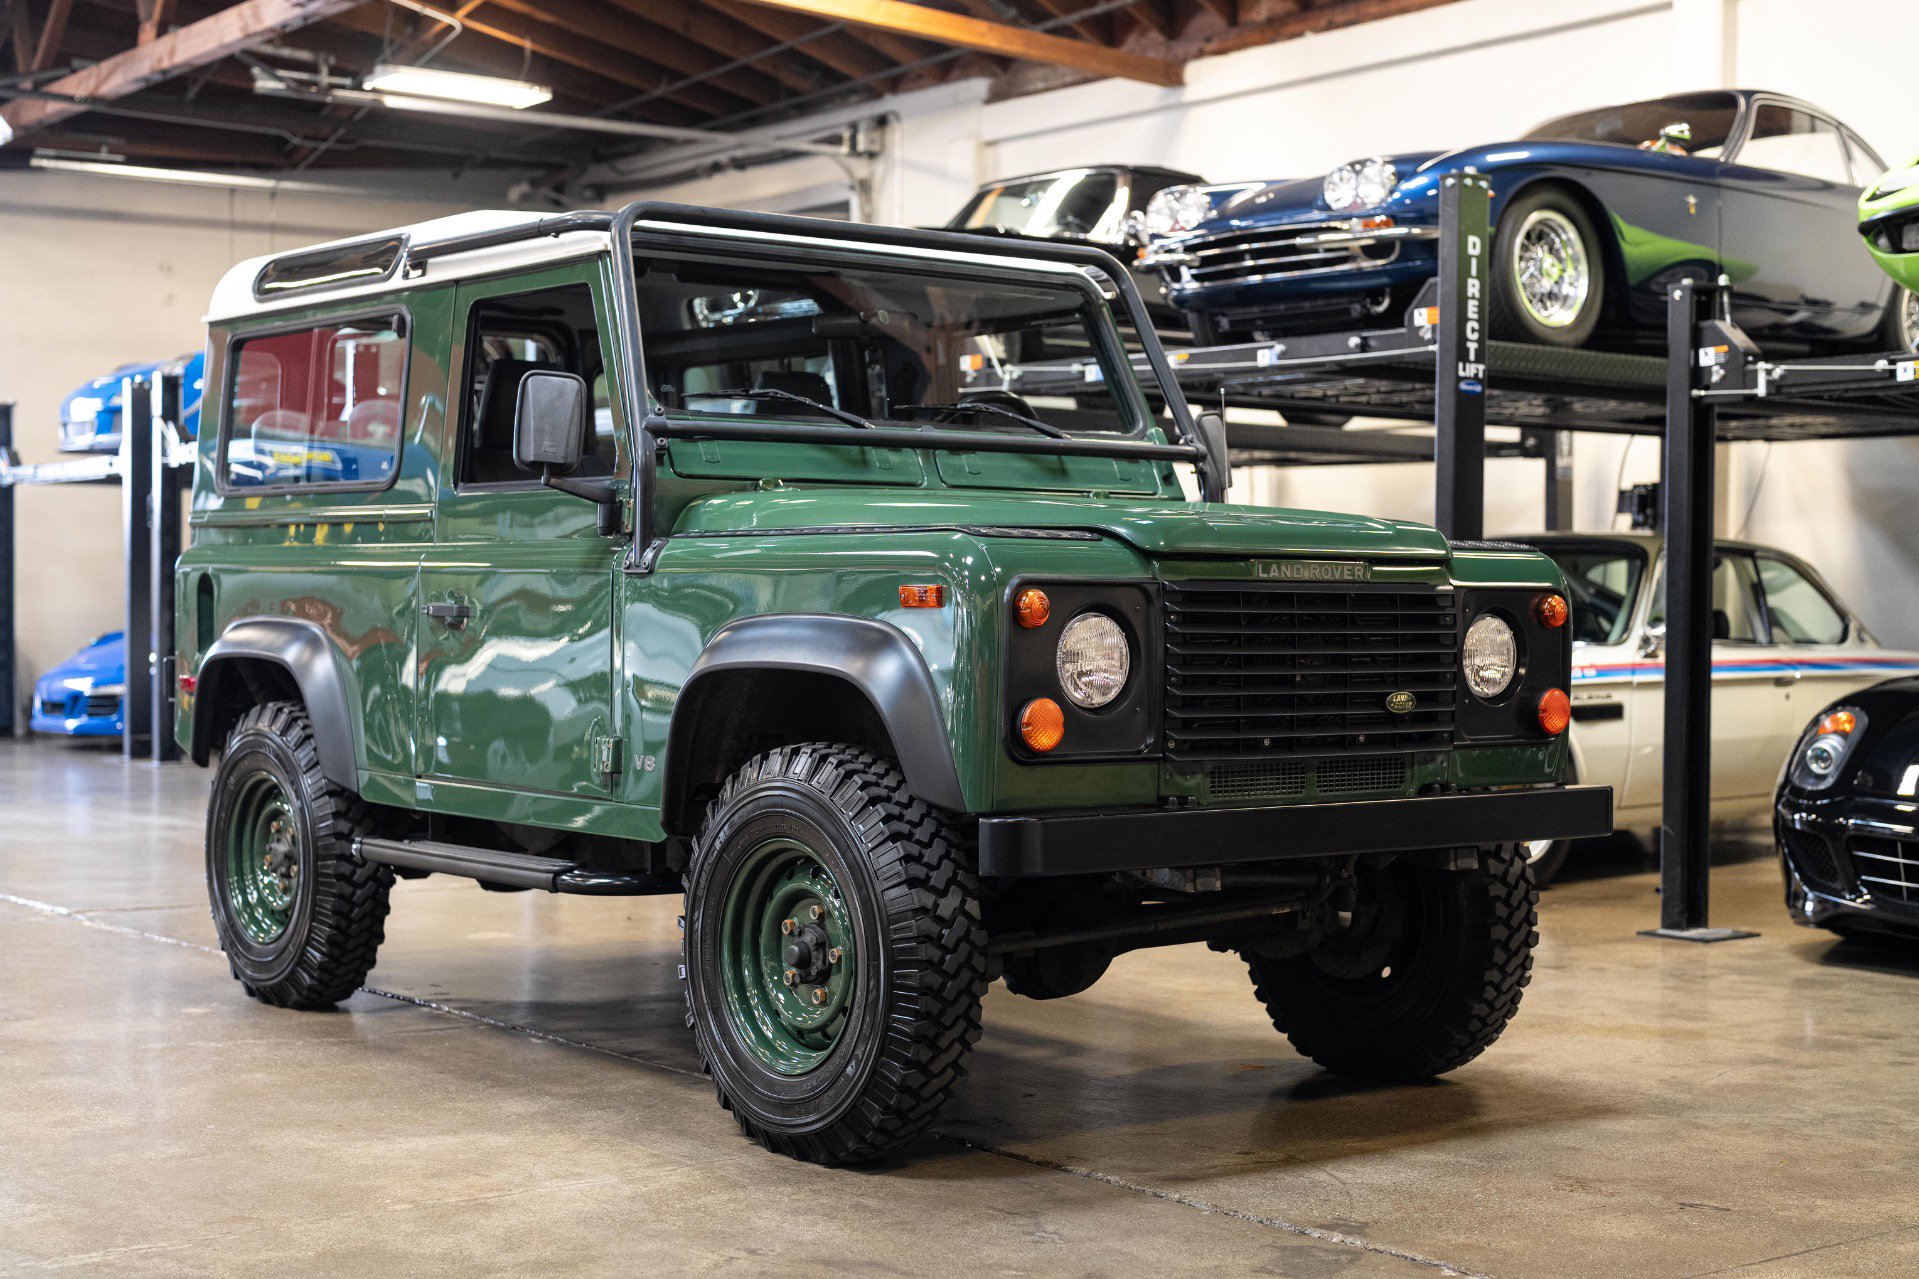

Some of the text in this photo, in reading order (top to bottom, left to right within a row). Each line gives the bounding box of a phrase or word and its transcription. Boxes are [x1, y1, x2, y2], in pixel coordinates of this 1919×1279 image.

[1465, 234, 1481, 361] DIRECT
[1458, 361, 1486, 378] LIFT
[1258, 563, 1365, 580] LAND ROVER
[634, 754, 656, 772] V8
